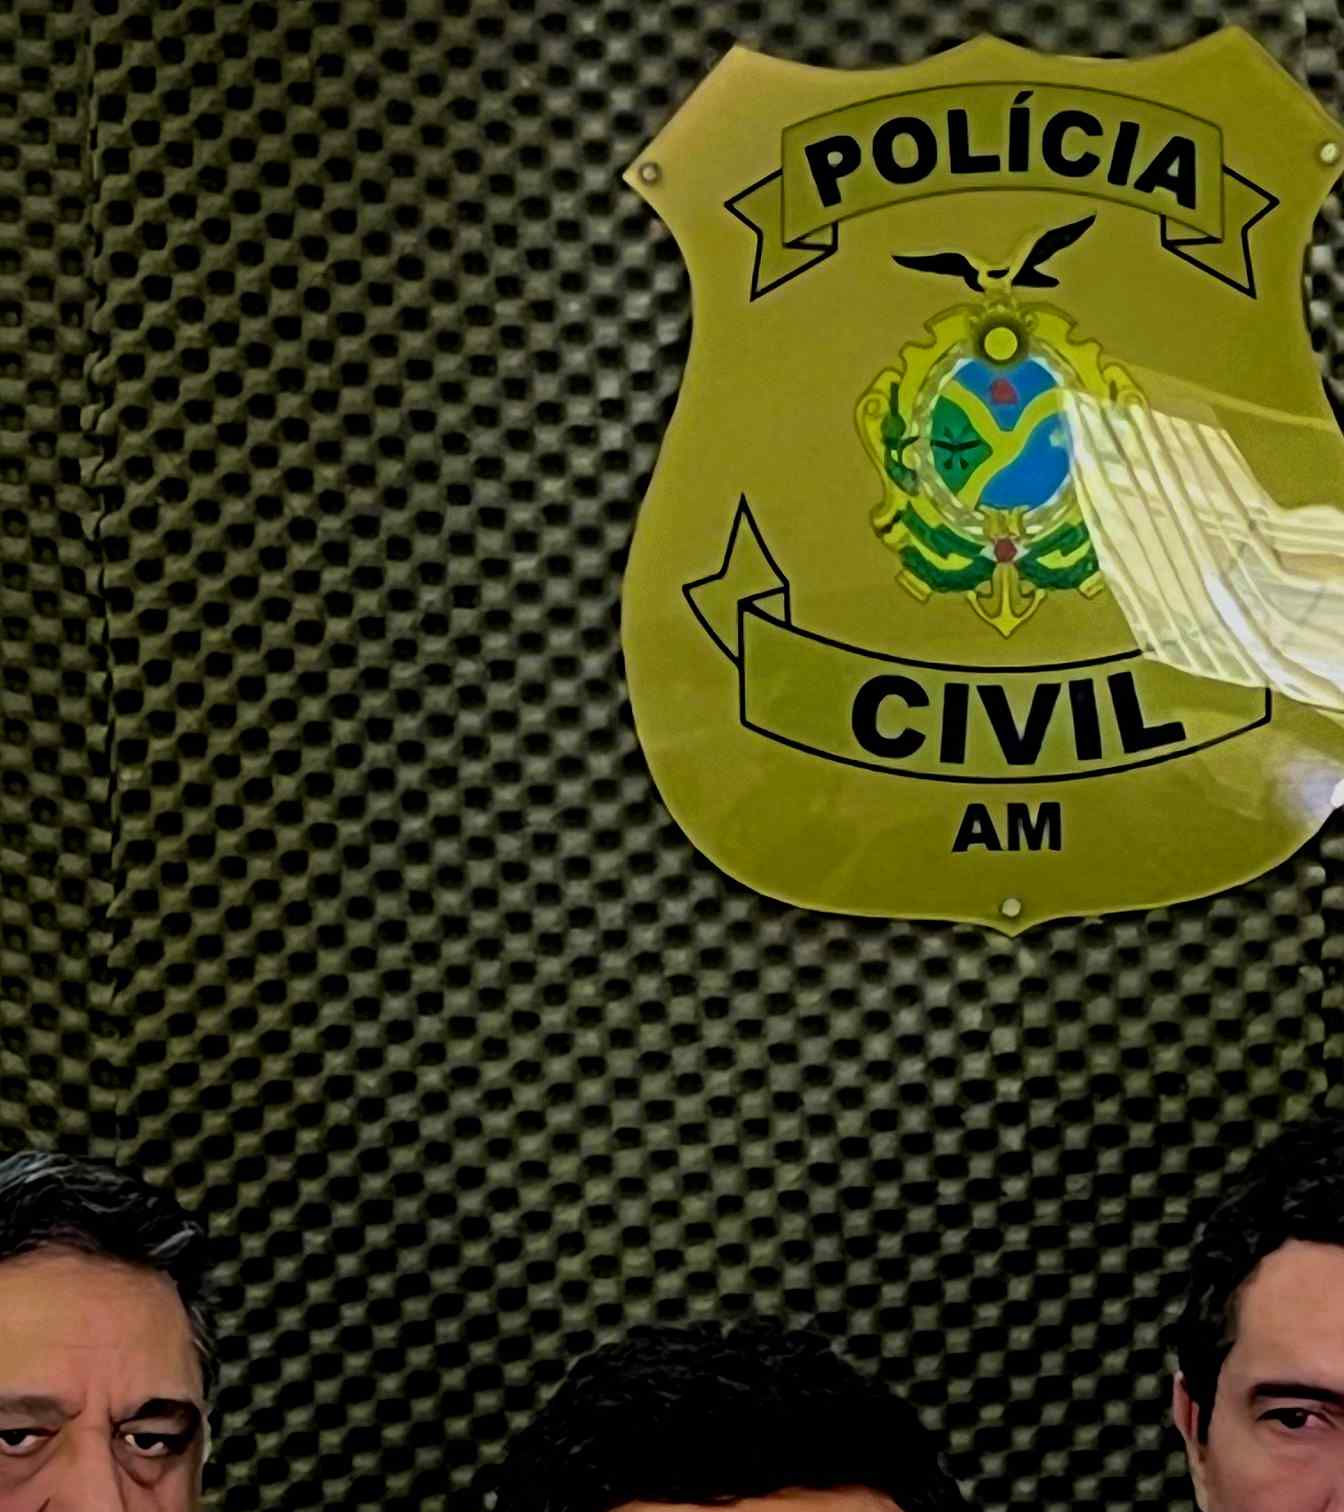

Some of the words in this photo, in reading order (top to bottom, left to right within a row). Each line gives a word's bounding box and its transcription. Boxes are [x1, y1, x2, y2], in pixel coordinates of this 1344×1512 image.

[804, 90, 1198, 209] POLÍCIA
[851, 671, 1186, 767] CIVIL
[951, 801, 1063, 853] AM
